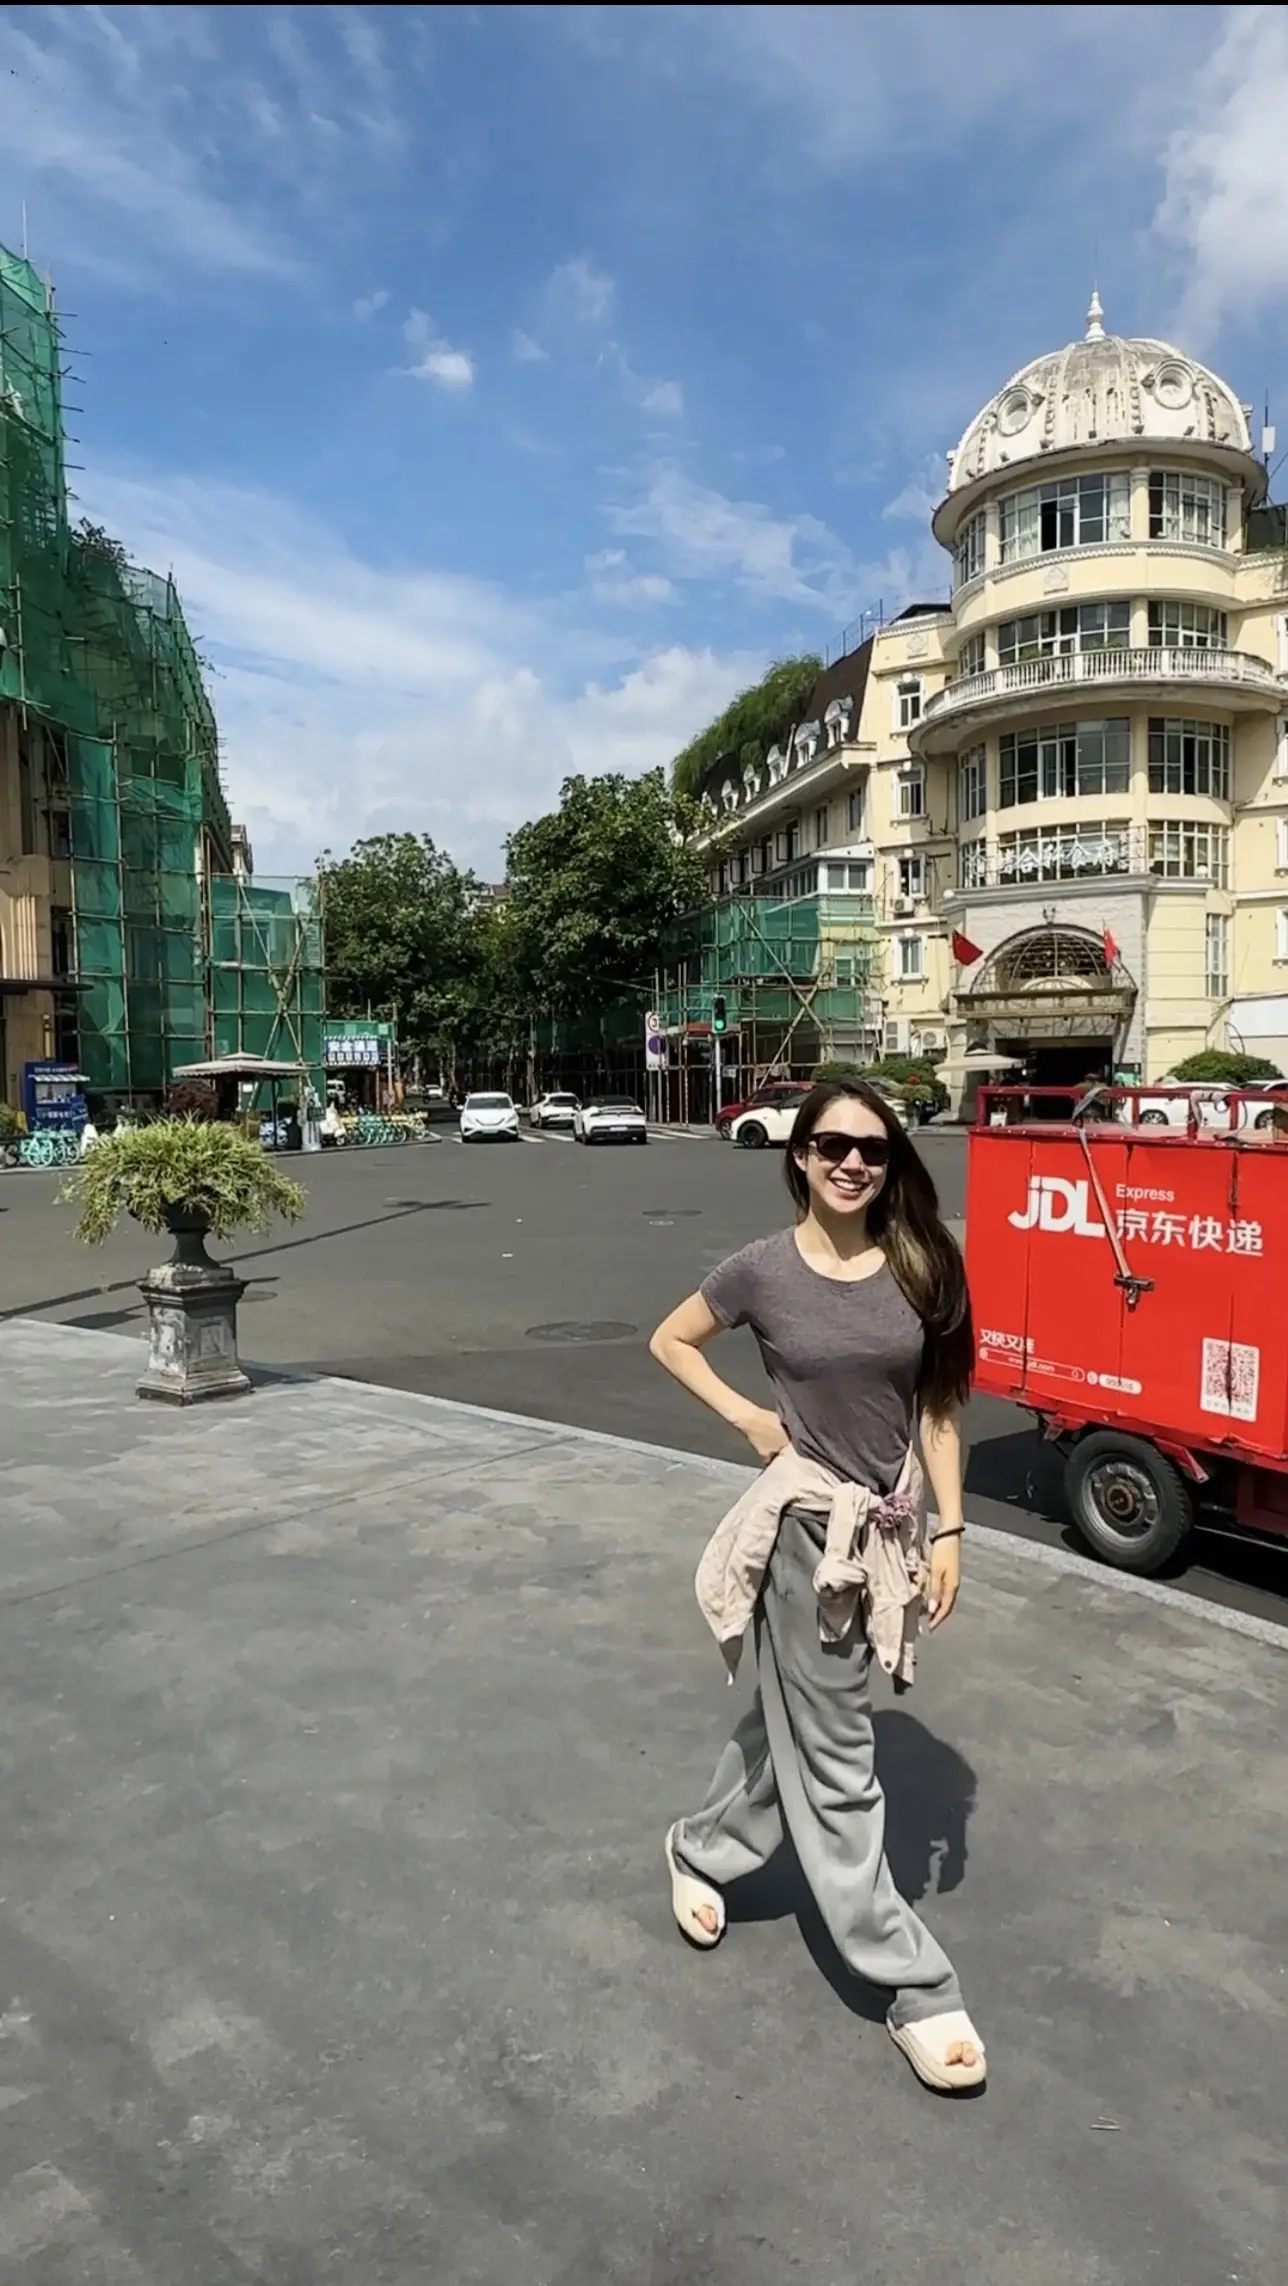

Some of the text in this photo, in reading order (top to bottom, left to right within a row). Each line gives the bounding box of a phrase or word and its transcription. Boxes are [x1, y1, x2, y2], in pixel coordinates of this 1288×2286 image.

[1007, 1175, 1106, 1238] JDL
[1115, 1183, 1175, 1202] Express
[1114, 1207, 1264, 1257] 京东快递
